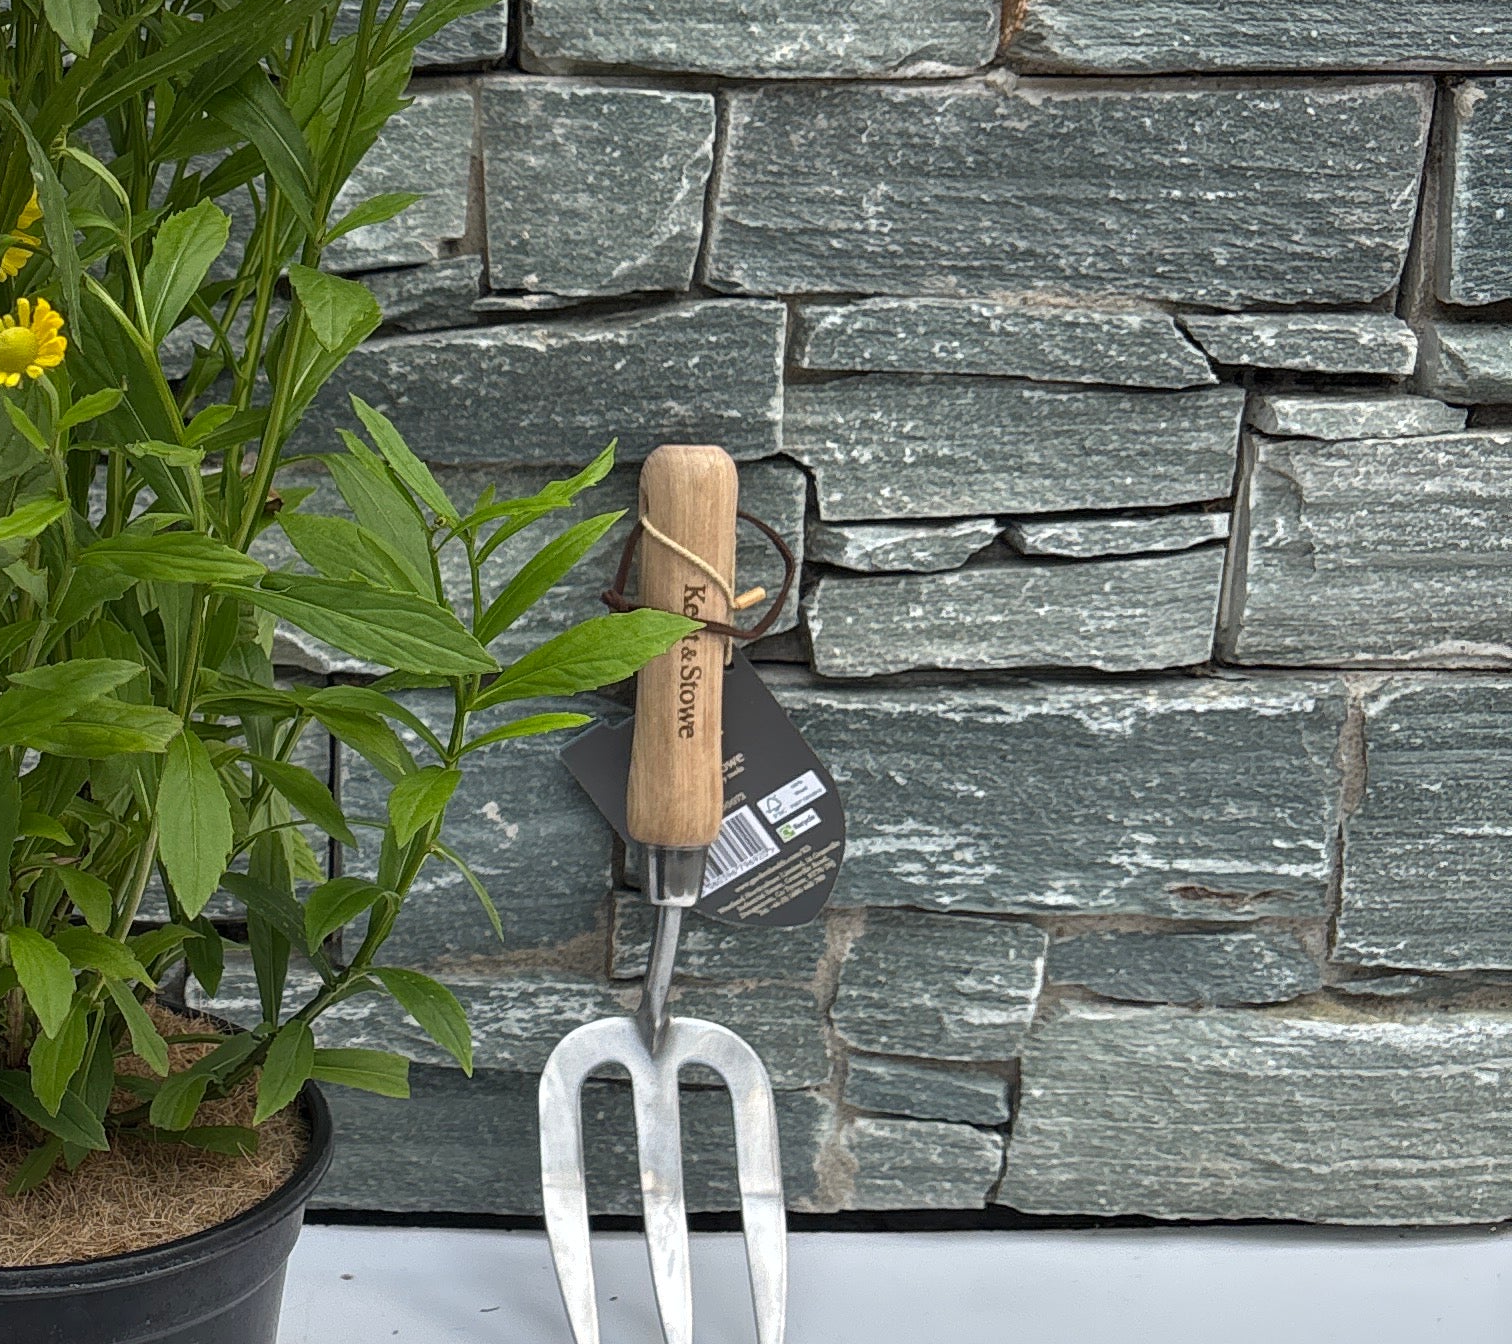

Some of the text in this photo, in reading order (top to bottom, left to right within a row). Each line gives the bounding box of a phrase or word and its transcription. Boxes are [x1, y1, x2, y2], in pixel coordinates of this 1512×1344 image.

[677, 584, 707, 739] Ket & Stowe
